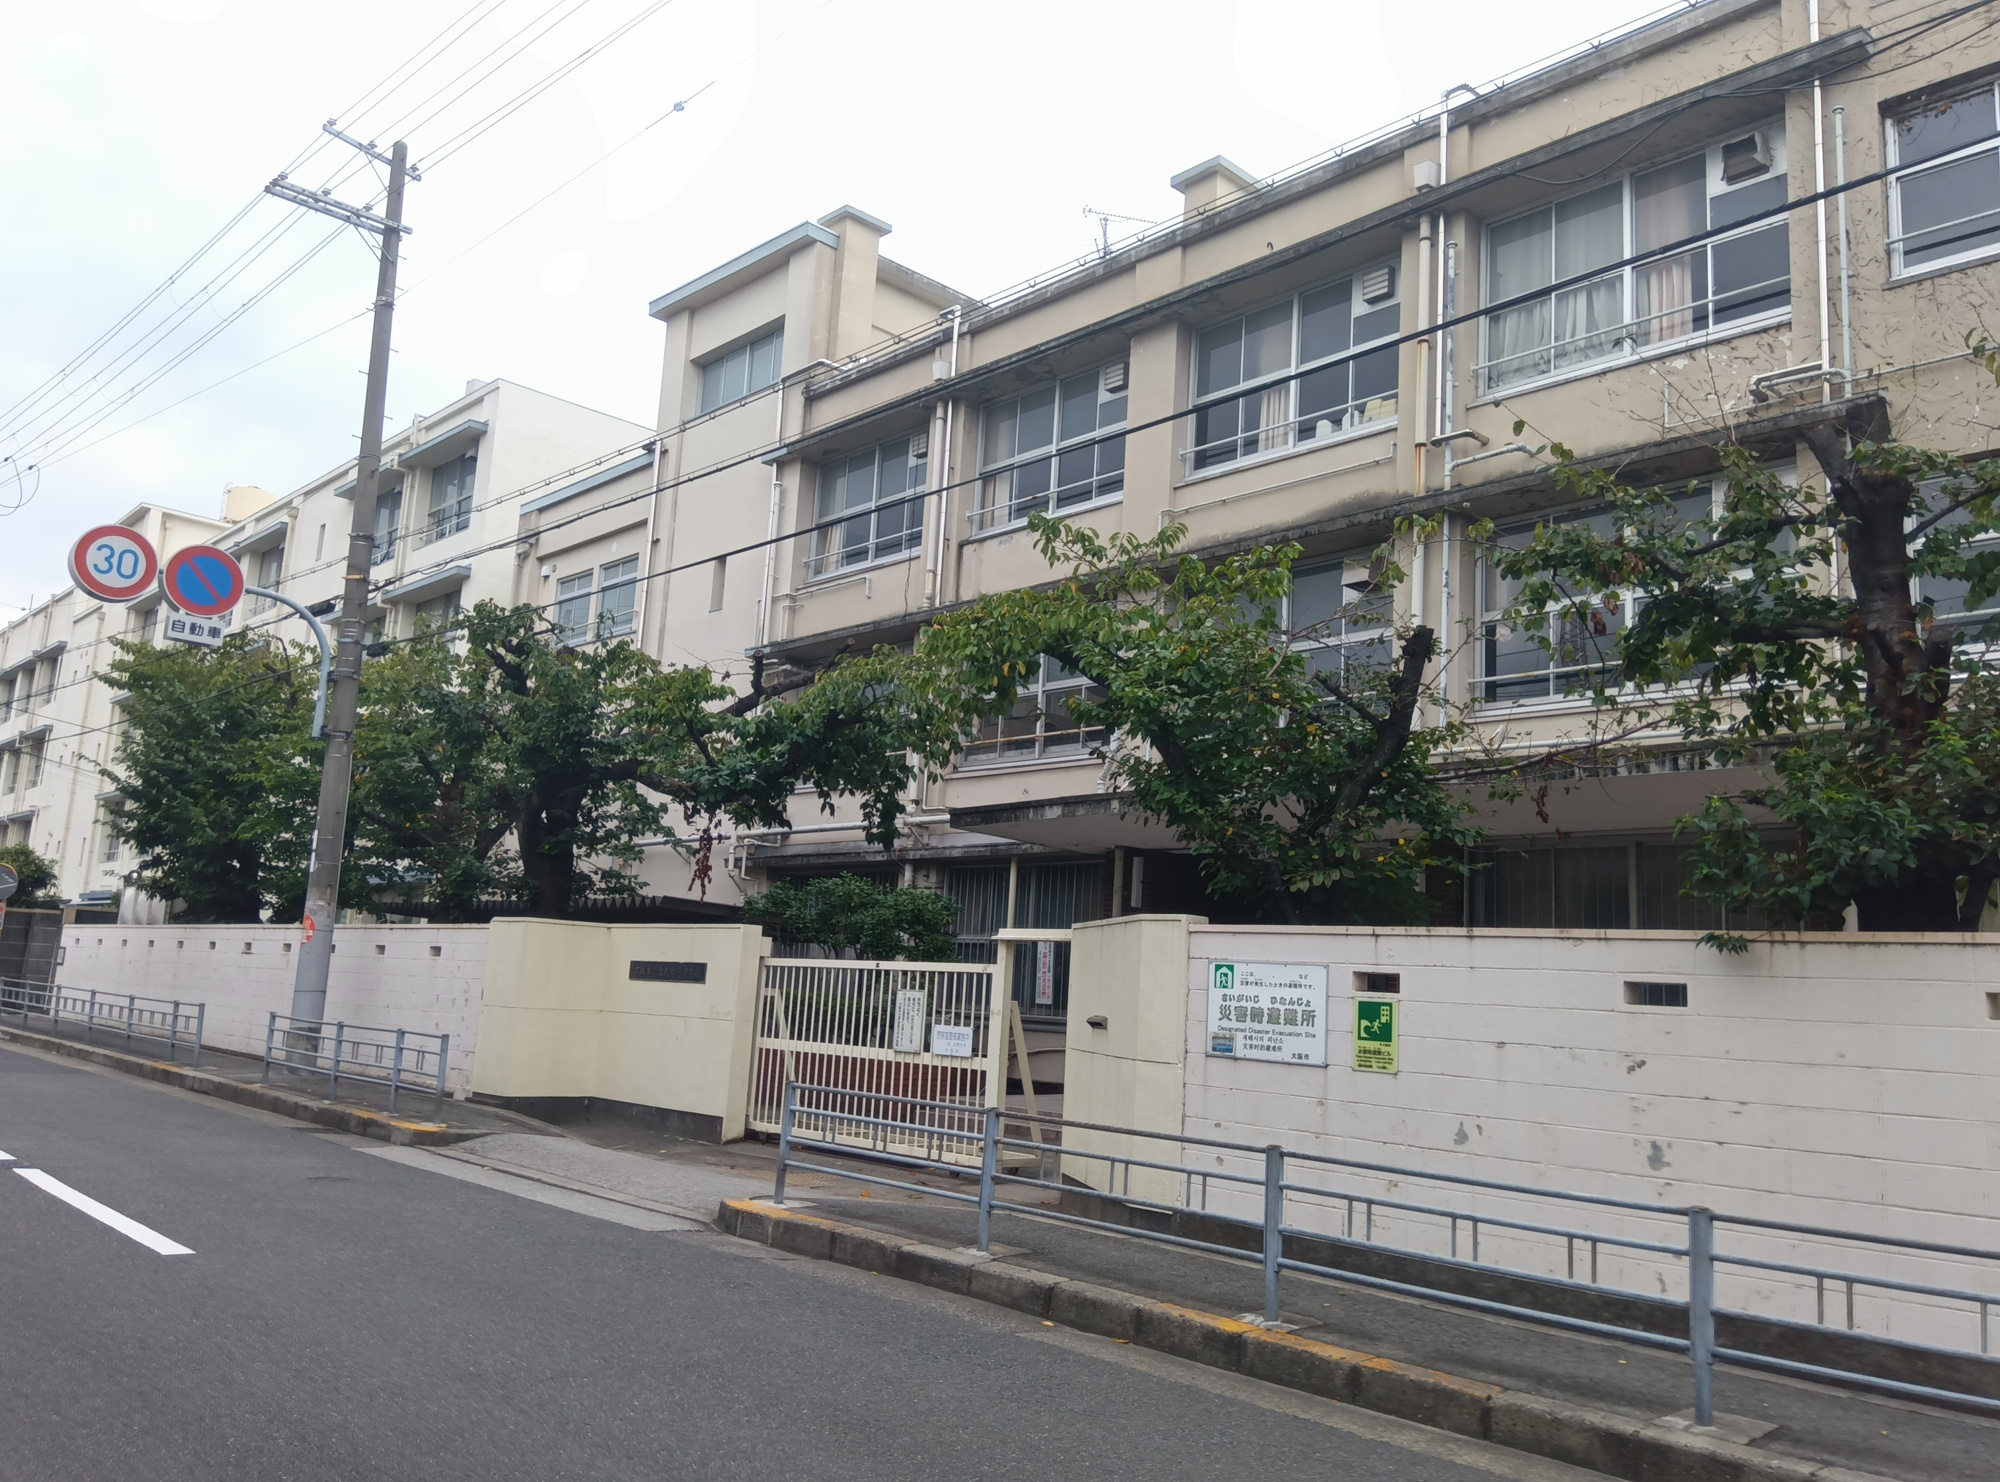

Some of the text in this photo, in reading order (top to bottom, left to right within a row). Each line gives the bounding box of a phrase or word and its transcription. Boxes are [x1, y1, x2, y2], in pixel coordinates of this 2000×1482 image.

[93, 543, 140, 580] 30
[171, 619, 223, 640] 自動車
[1218, 1003, 1317, 1028] 災害時避難所
[1217, 1025, 1316, 1039] Designated Disaster Evacuation Site
